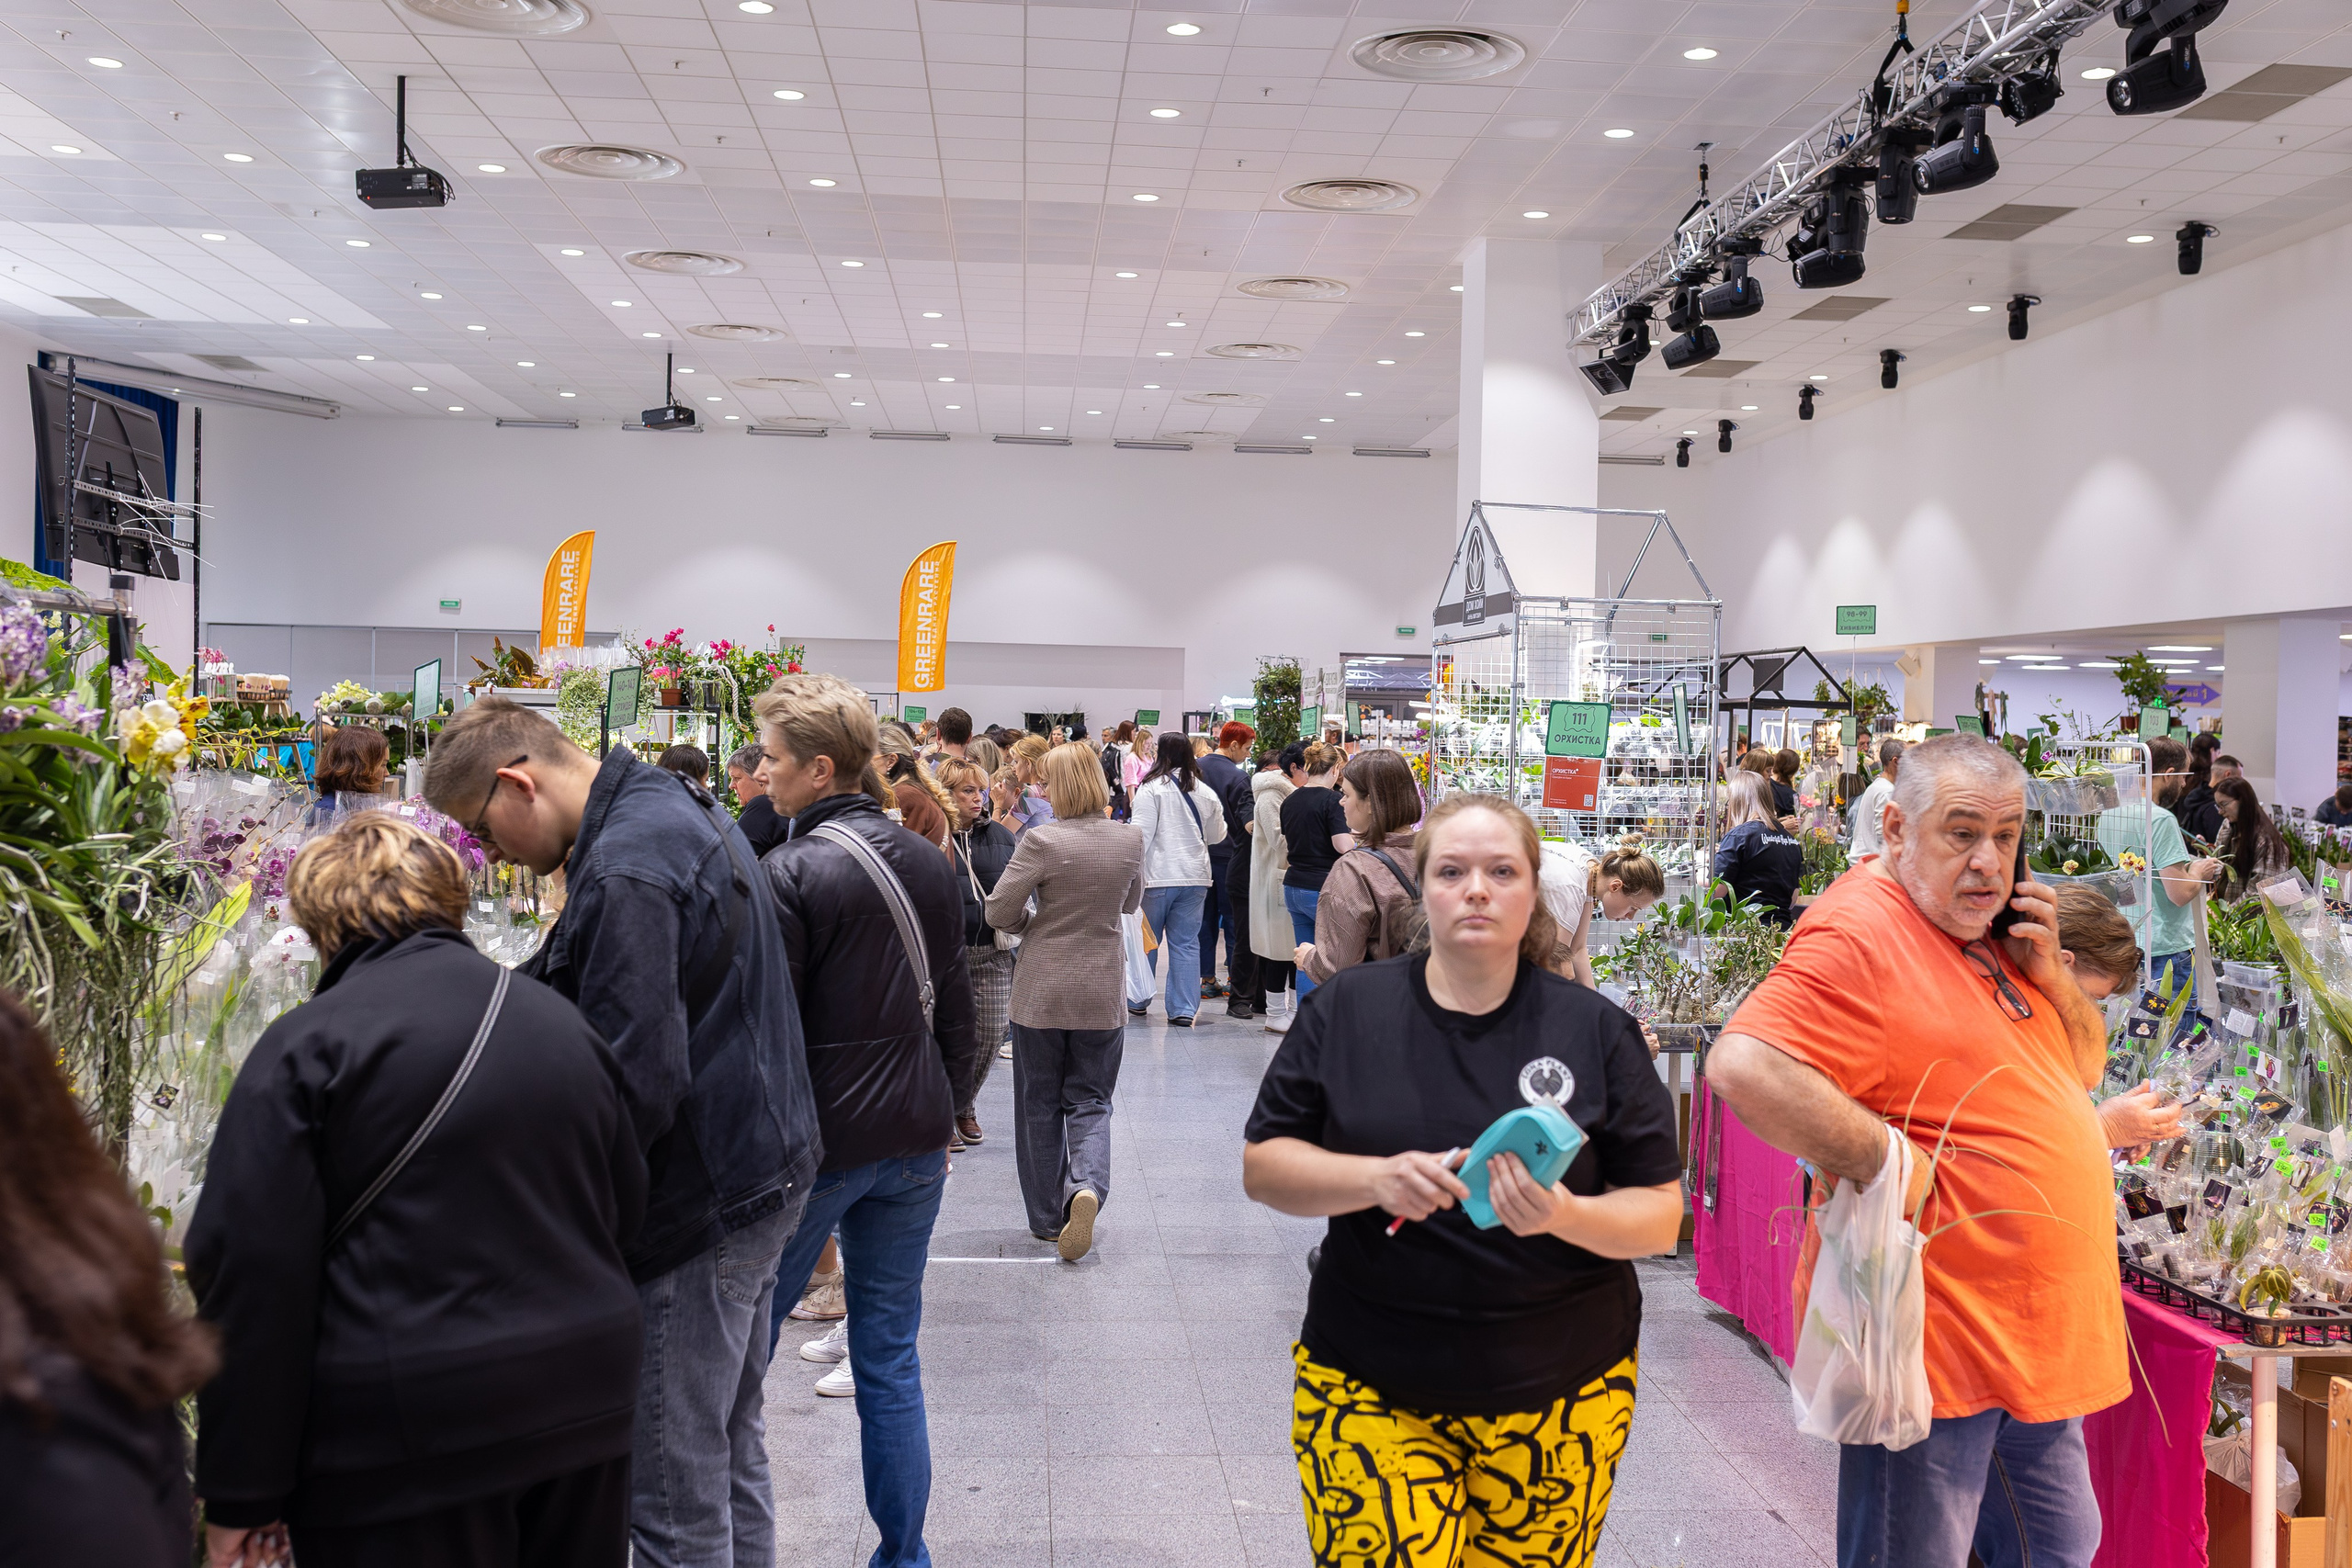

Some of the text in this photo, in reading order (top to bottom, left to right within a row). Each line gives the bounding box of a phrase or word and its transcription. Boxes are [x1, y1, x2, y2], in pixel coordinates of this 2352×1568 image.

[557, 550, 575, 648] EENRARE
[1846, 610, 1868, 618] 98-99
[914, 560, 935, 688] GREENRARE
[1572, 712, 1588, 726] 111
[1554, 734, 1601, 745] ОРХИСТКА
